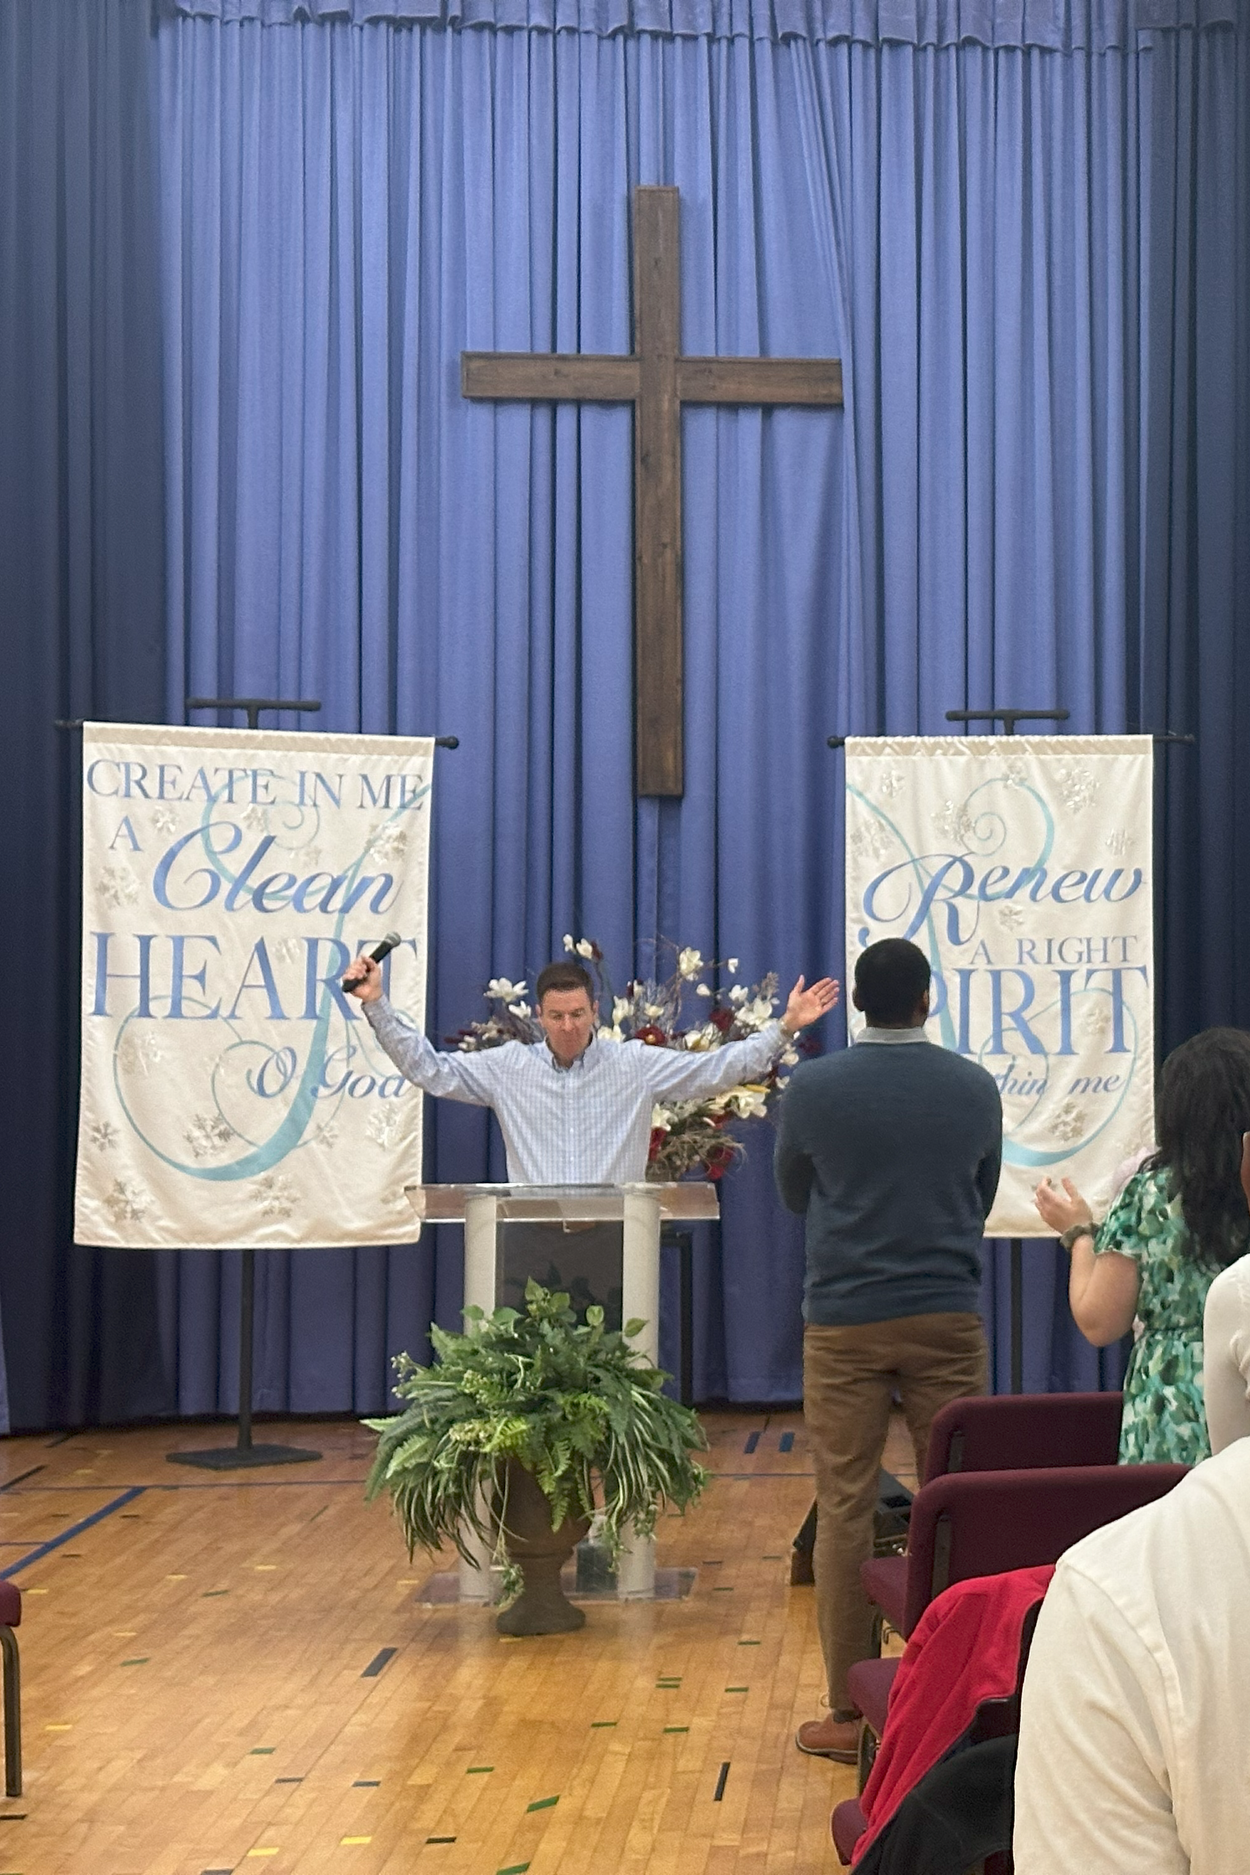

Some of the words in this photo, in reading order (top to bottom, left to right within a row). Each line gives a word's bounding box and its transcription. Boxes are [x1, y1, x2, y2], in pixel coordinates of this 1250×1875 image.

[87, 758, 277, 805] CREATE
[296, 769, 344, 810] IN
[356, 772, 425, 812] ME
[108, 814, 144, 853] A
[152, 820, 404, 915] Clean
[858, 852, 1147, 947] Renew
[970, 939, 994, 965] A
[1016, 935, 1138, 966] RIGHT
[929, 964, 1150, 1056] IRIT
[246, 1046, 298, 1099] O
[1067, 1074, 1125, 1096] me
